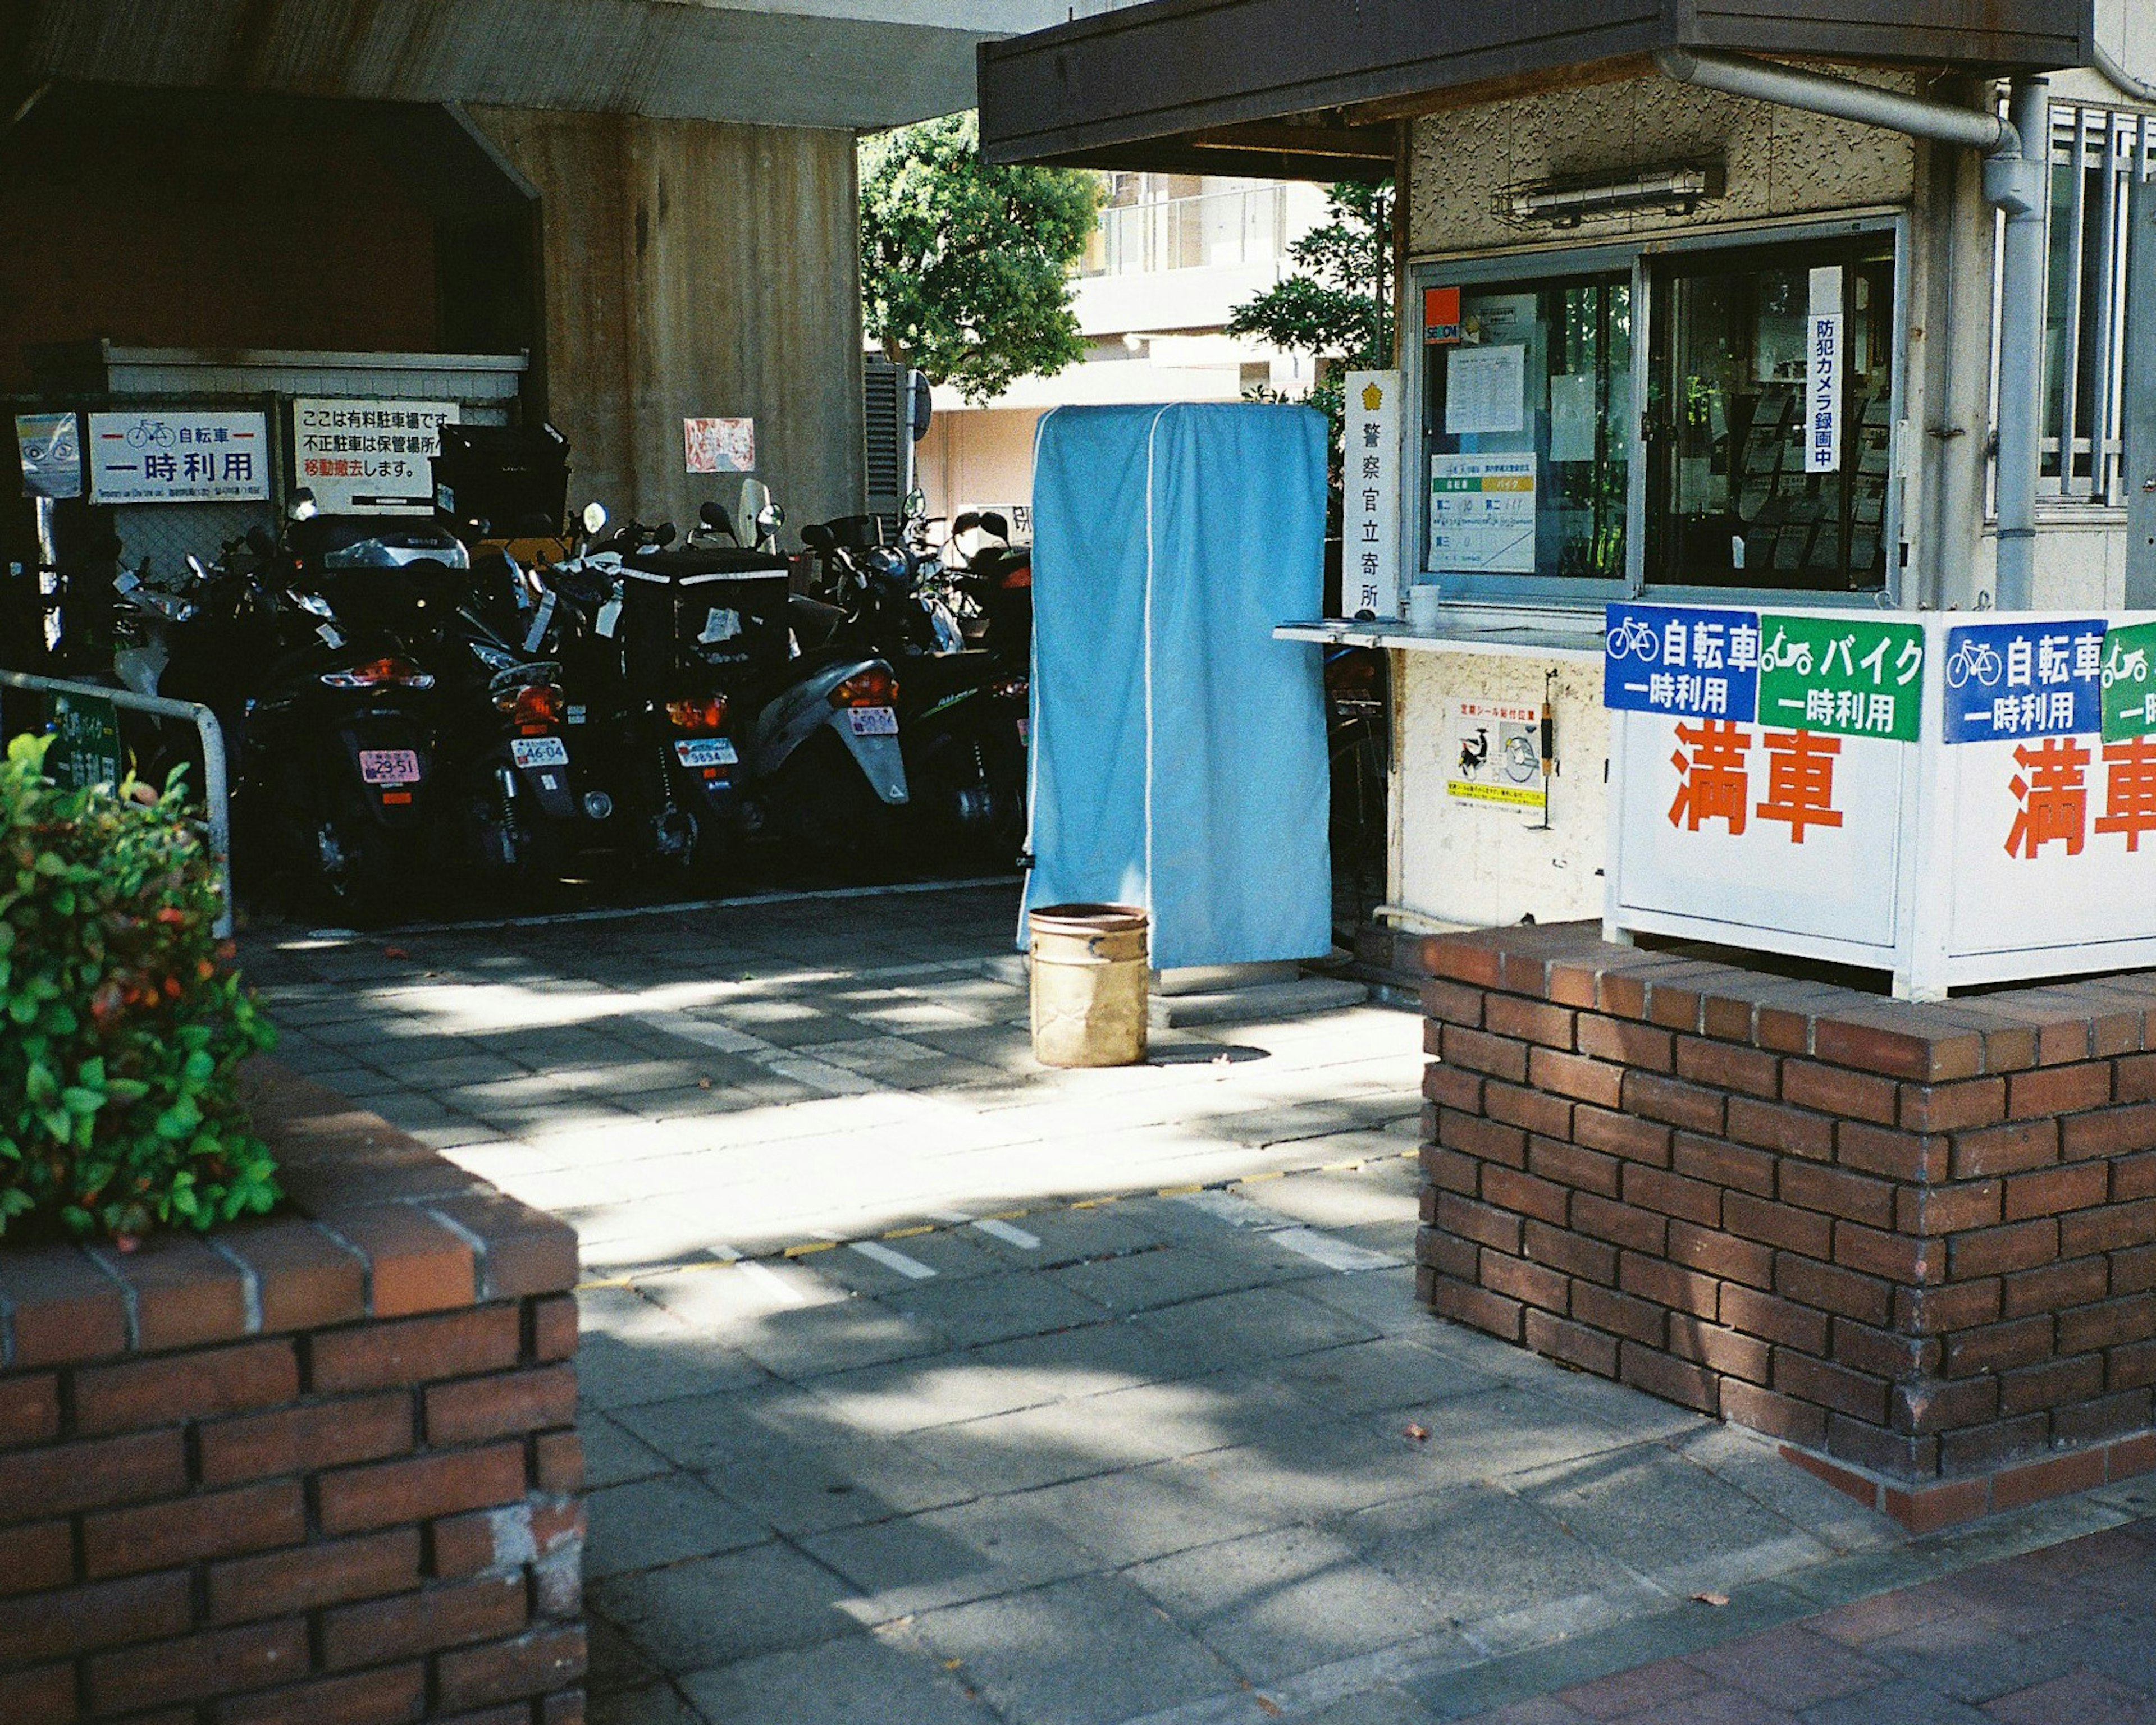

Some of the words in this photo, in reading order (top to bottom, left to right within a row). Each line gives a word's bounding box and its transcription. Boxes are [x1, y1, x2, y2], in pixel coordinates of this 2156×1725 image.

[1815, 320, 1834, 466] 防犯カメラ録画中
[179, 427, 229, 443] 自転車
[303, 410, 448, 429] ここは有料駐車場です
[106, 452, 252, 482] 一時利用
[304, 459, 413, 477] 移動撤去します。
[1361, 422, 1381, 607] 警察官立寄所
[1663, 619, 1758, 672] 自転車
[1819, 634, 1924, 685] バイク
[2006, 632, 2104, 688] 自転車
[1624, 672, 1728, 715] 一時利用
[1778, 688, 1895, 733] 一時利用
[1965, 691, 2074, 733] 一時利用
[1668, 719, 1843, 844] 満車
[2003, 737, 2156, 859] 満車
